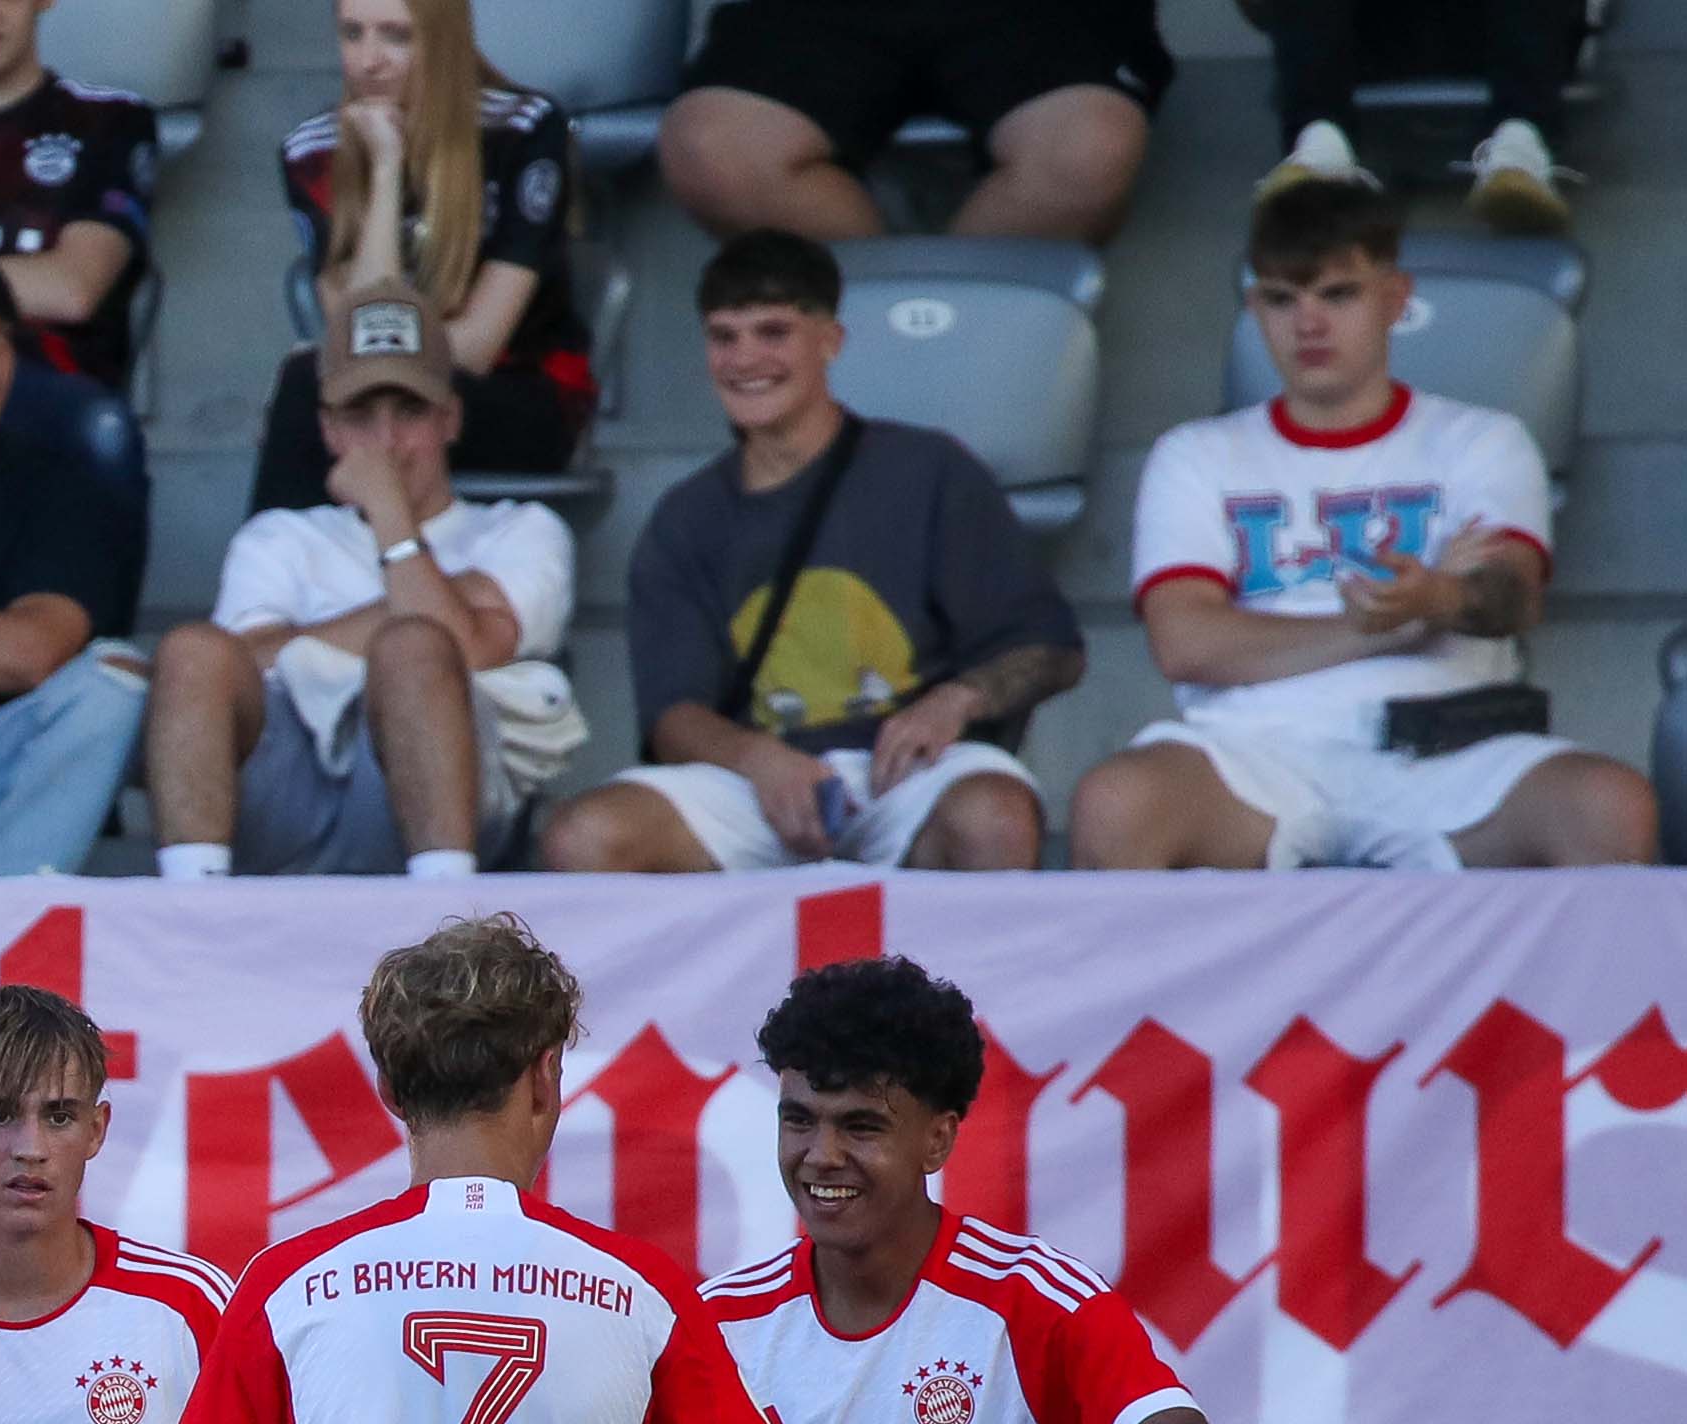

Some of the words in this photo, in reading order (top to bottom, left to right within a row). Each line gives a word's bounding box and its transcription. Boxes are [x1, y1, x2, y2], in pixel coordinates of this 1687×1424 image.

[305, 1270, 339, 1305] FC
[354, 1260, 476, 1295] BAYERN
[492, 1264, 633, 1317] MÜNCHEN
